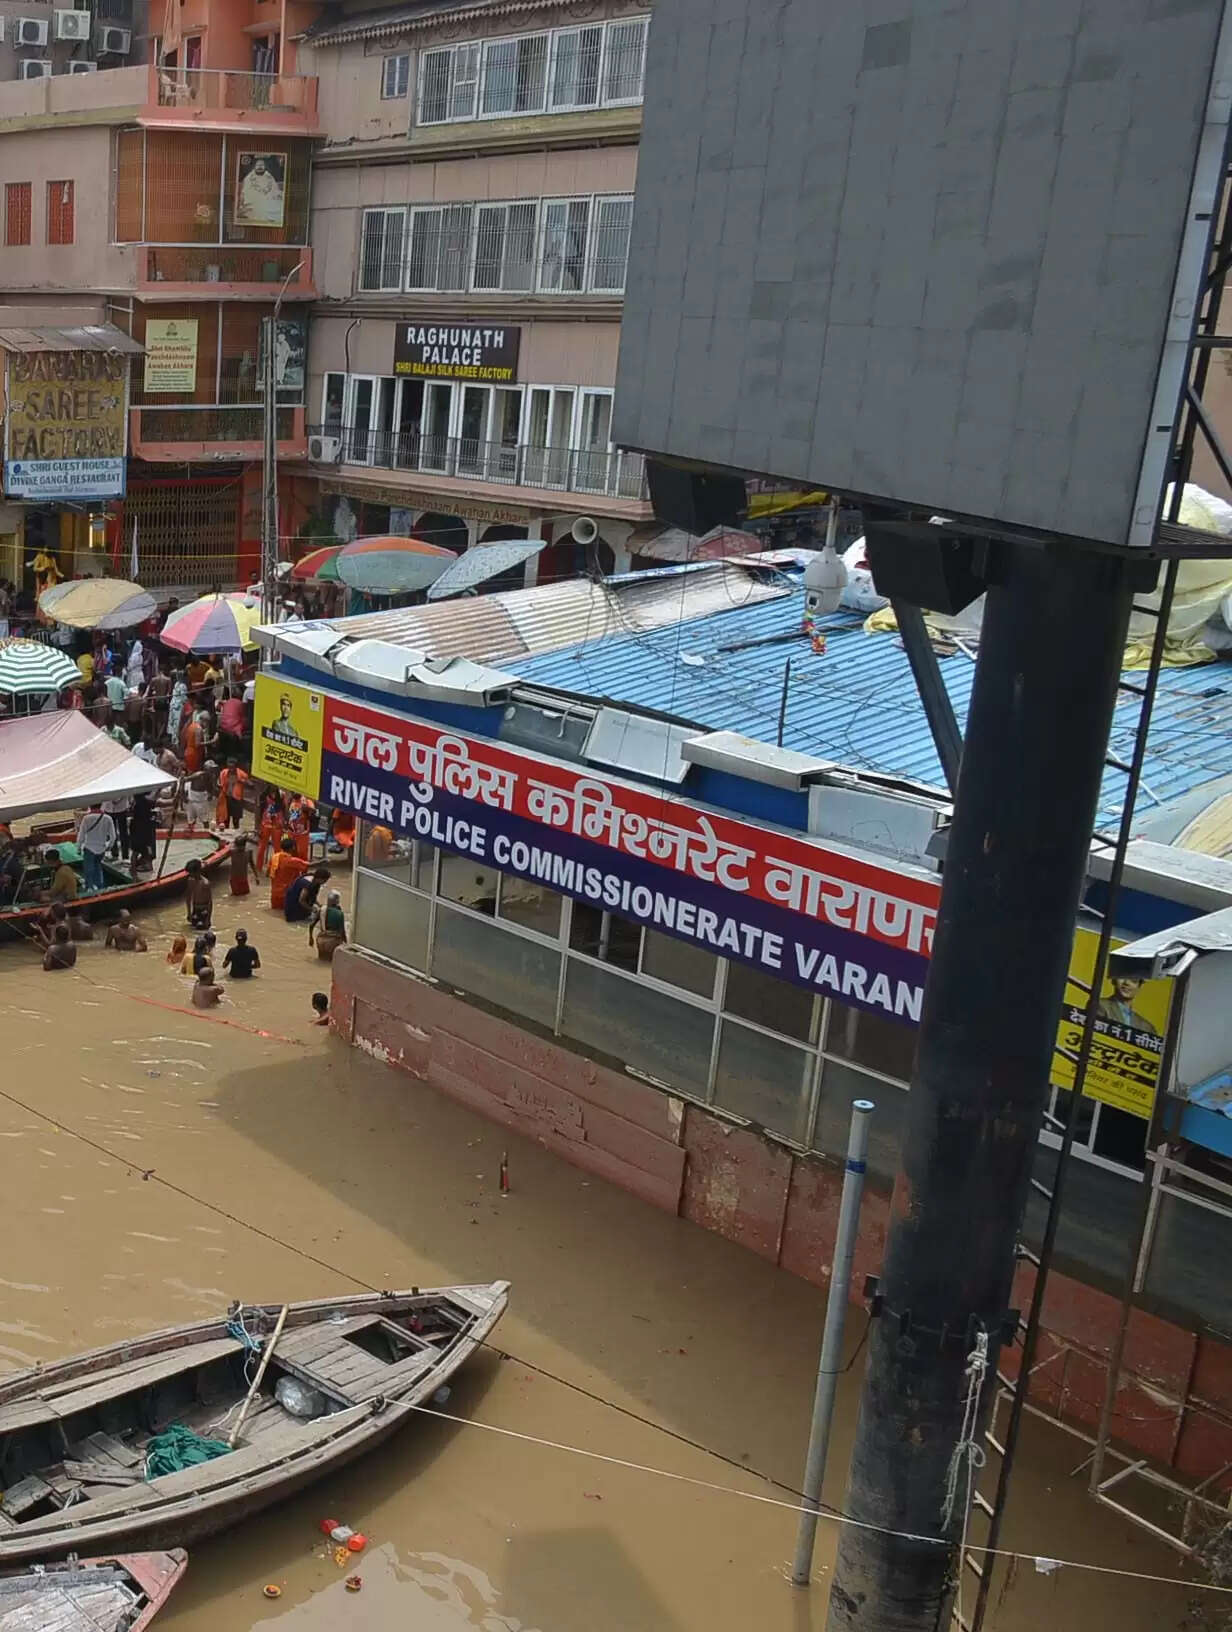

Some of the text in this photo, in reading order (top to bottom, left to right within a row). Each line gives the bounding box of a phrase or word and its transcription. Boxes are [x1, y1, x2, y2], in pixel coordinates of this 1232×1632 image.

[407, 327, 504, 348] RAGHUNATH
[422, 346, 482, 366] PALACE
[396, 361, 411, 373] SHRI
[438, 364, 453, 377] SILK
[455, 365, 478, 379] SAREE
[479, 366, 512, 380] FACTORY
[25, 388, 101, 422] SAREE
[11, 427, 119, 459] FACTORY
[54, 462, 80, 471] GUEST
[82, 461, 109, 470] HOUSE
[332, 716, 403, 773] जल
[408, 734, 517, 812] पुलिस
[526, 777, 757, 894] कमिश्नरेट
[330, 775, 394, 823] RIVER
[400, 801, 487, 857] POLICE
[493, 833, 784, 969] COMMISSIONERATE
